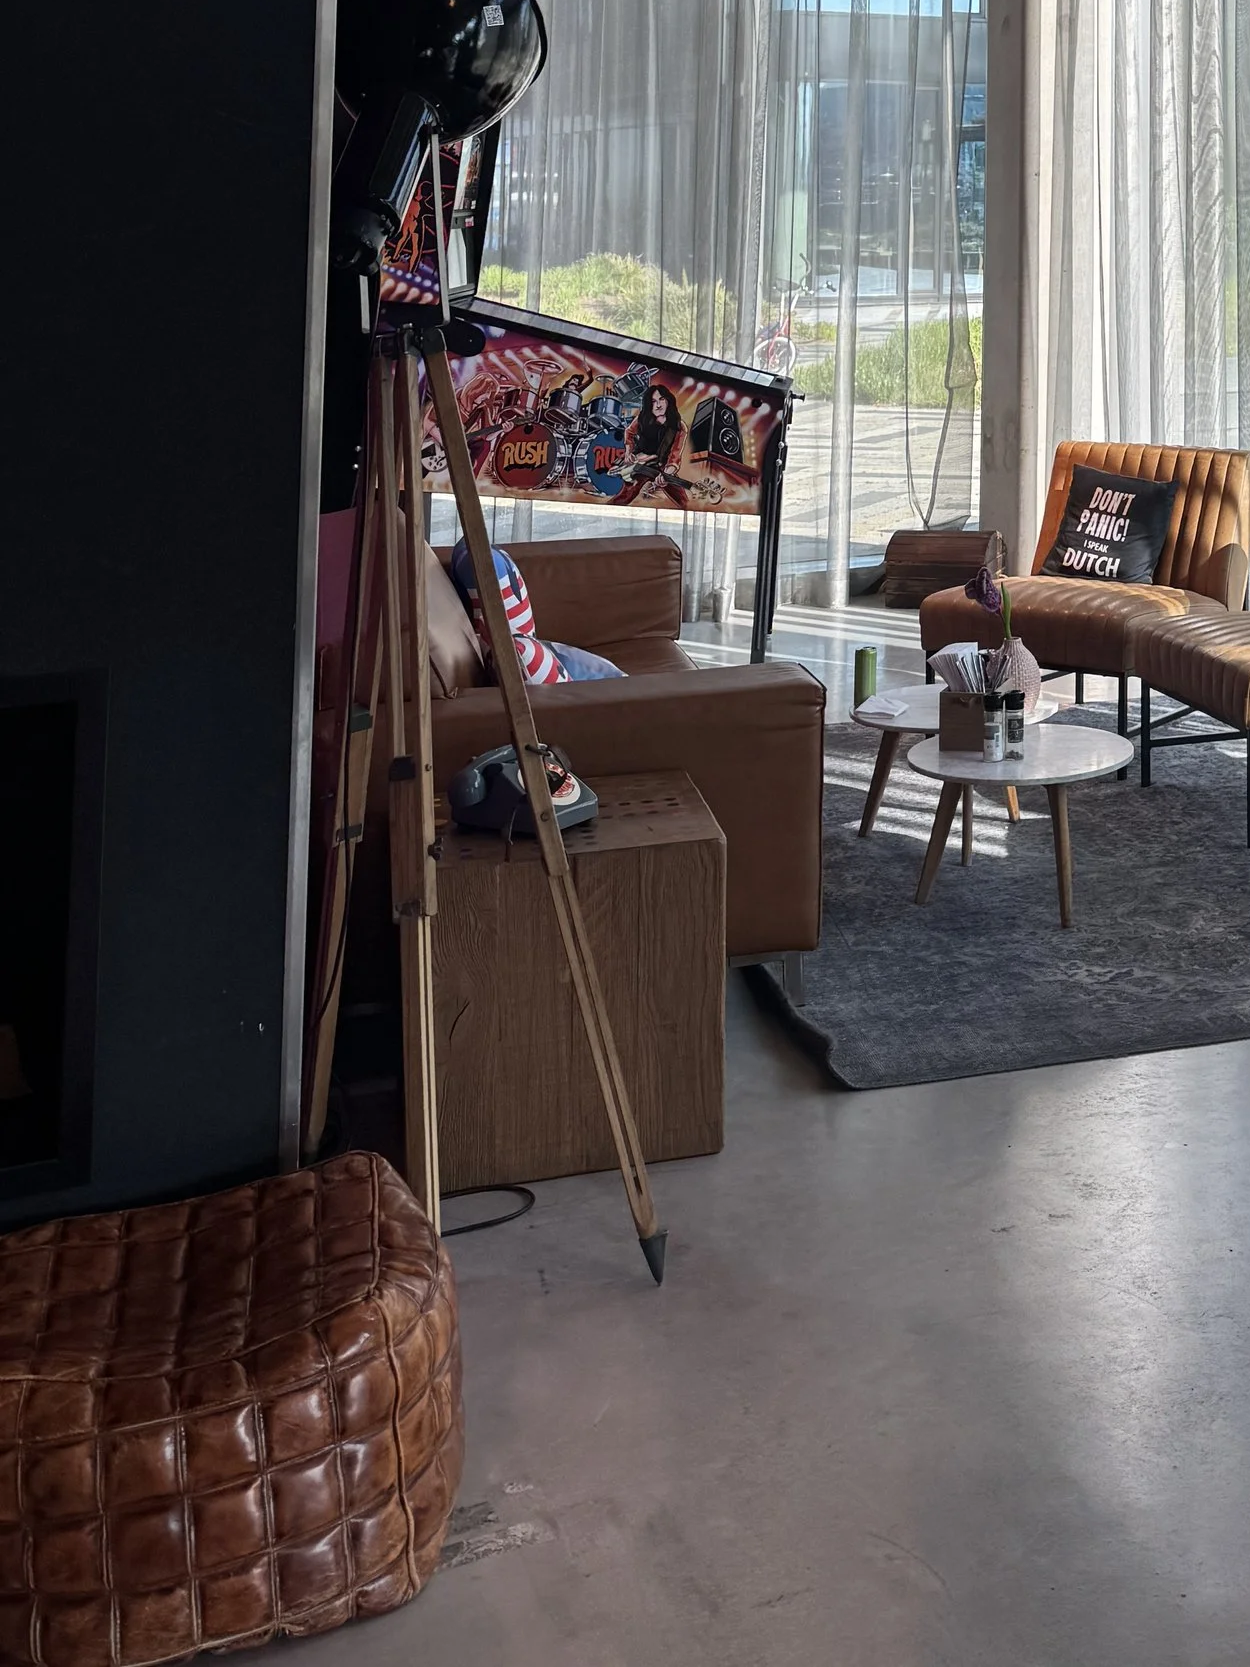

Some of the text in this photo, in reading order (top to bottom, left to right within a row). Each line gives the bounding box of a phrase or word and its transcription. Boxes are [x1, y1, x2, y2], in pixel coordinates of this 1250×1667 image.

[501, 440, 550, 470] RUSH
[1088, 486, 1137, 516] DON'T
[1076, 508, 1130, 542] PANIC!
[1083, 539, 1109, 553] I SPEAK
[1062, 547, 1121, 578] DUTCH
